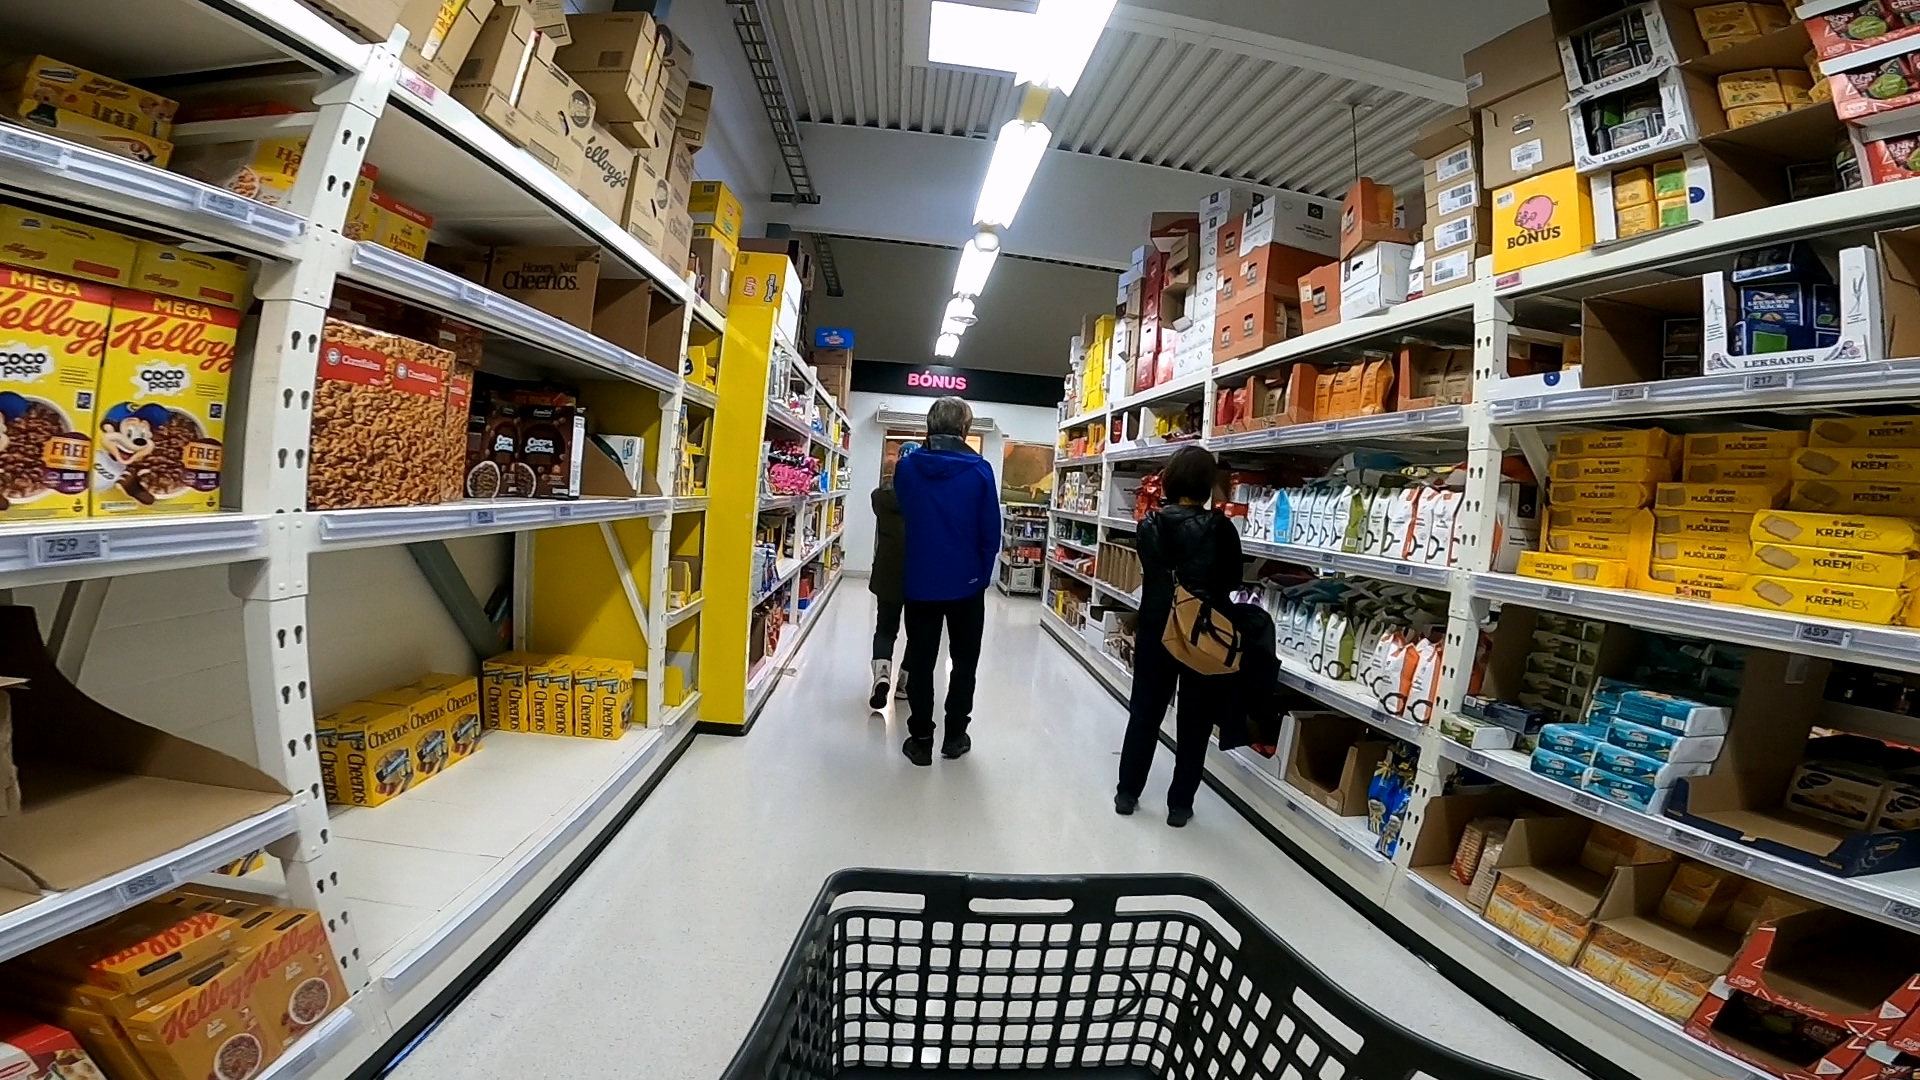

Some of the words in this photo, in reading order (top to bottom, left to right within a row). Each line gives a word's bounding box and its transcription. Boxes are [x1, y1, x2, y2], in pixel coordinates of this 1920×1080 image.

[1594, 69, 1642, 90] LEKSANDS
[1602, 143, 1651, 162] LEKSANDS
[1507, 226, 1561, 249] BÓNUS
[10, 270, 81, 297] MEGA
[502, 270, 580, 290] Cheerios
[153, 298, 213, 321] MEGA
[1744, 355, 1815, 368] LEKSANDS
[149, 380, 181, 391] pops
[908, 370, 967, 390] BÓNUS
[1754, 376, 1772, 385] 217
[51, 441, 89, 458] FREE
[188, 446, 220, 461] FREE
[1815, 528, 1883, 540] KREMKEX
[46, 537, 78, 552] 759
[1813, 558, 1880, 574] KREMKEX
[1805, 595, 1869, 611] KREMKEX
[1804, 627, 1829, 637] 459
[347, 753, 367, 804] Cheerios
